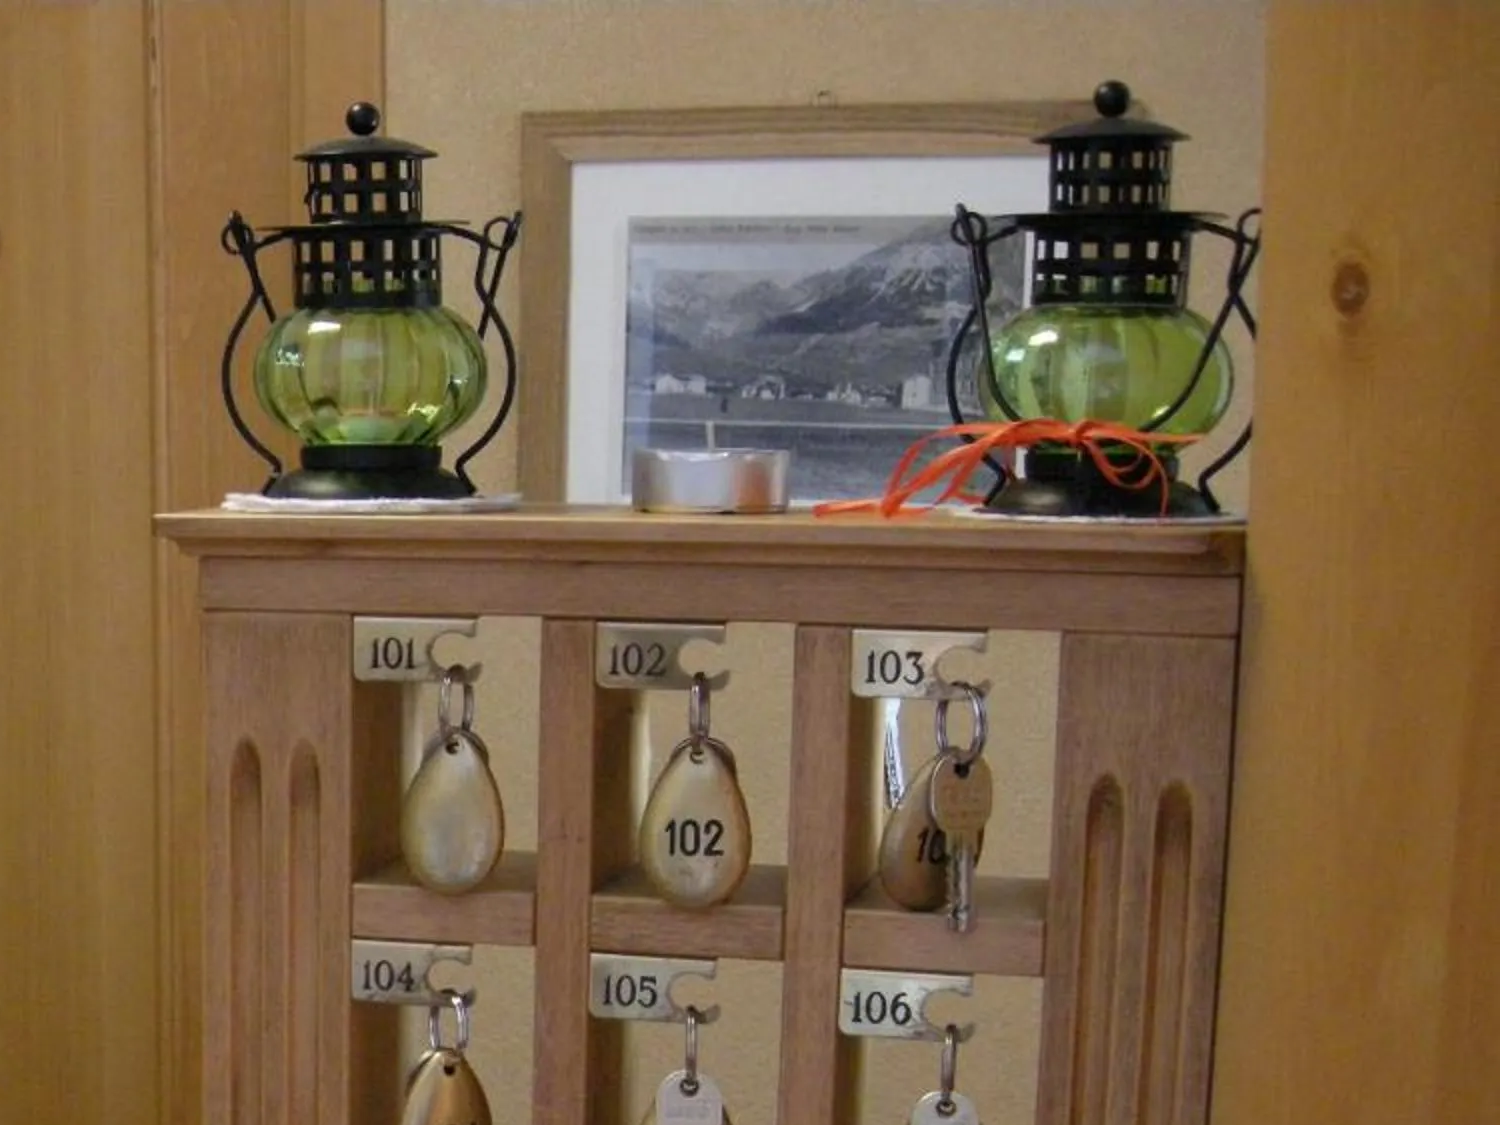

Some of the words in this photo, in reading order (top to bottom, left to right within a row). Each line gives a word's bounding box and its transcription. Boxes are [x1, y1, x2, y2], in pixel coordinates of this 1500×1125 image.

[368, 637, 417, 669] 101
[608, 643, 667, 676] 102
[864, 650, 925, 685] 103
[664, 818, 725, 857] 102
[917, 827, 949, 865] 10
[362, 959, 416, 992] 104
[602, 975, 659, 1008] 105
[851, 991, 913, 1026] 106
